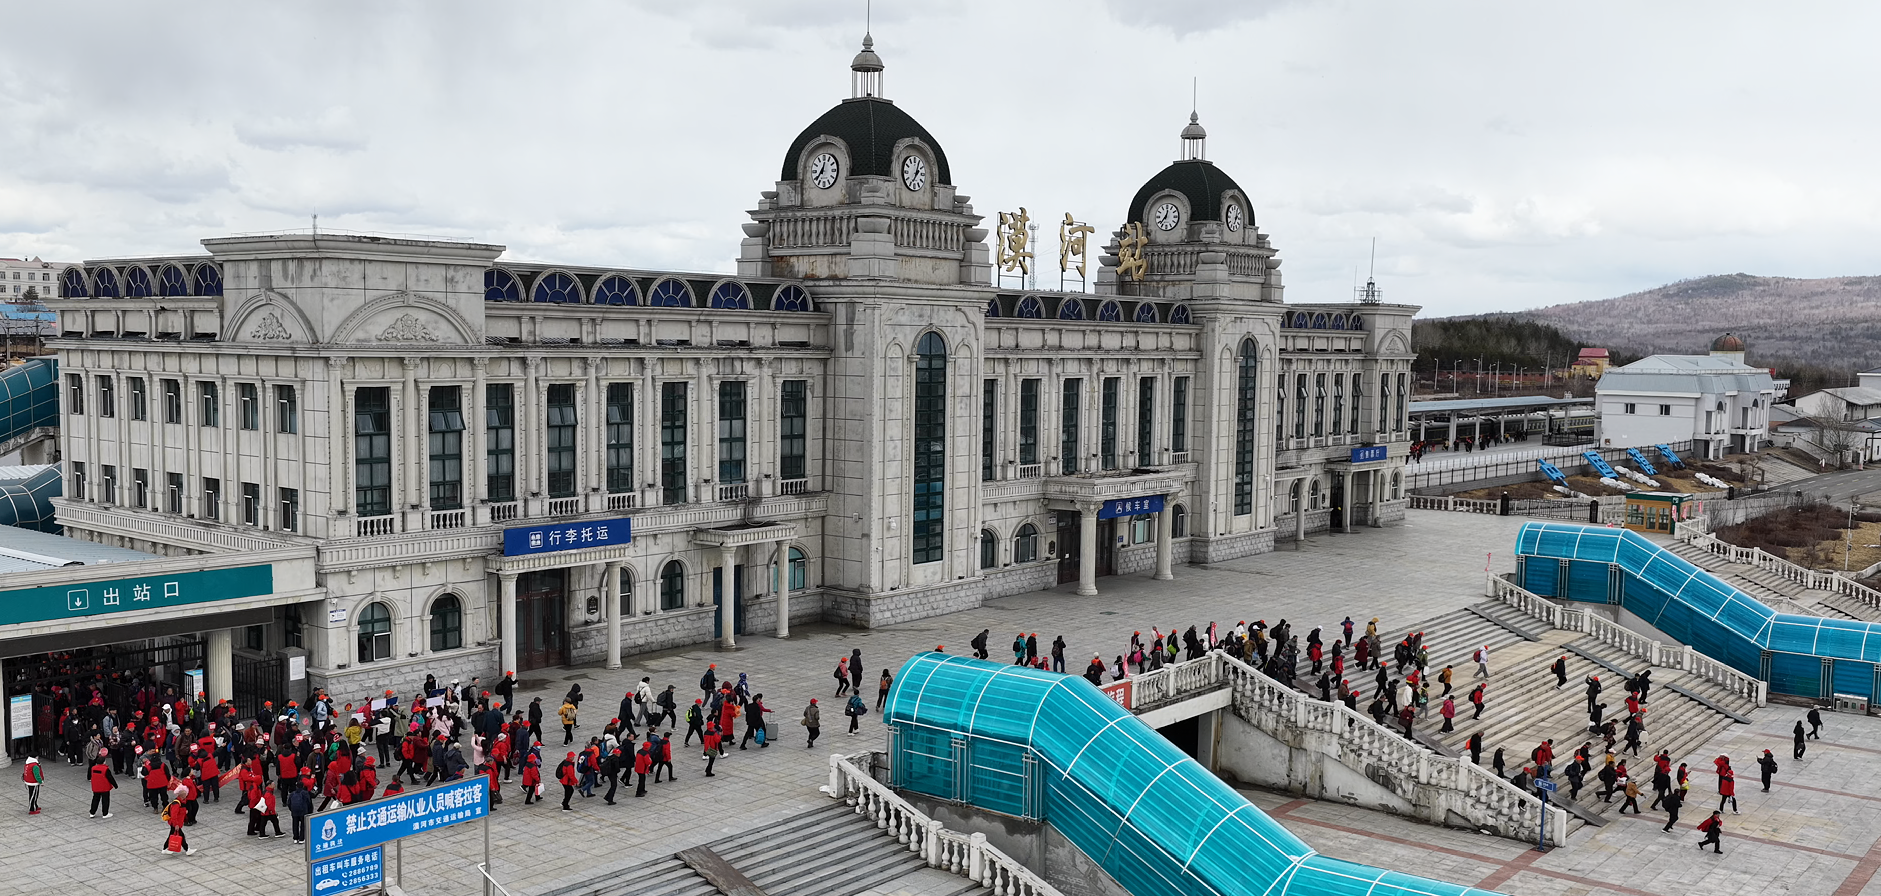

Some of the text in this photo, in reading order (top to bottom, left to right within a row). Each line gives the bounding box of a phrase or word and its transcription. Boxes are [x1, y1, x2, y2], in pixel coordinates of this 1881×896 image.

[997, 207, 1148, 281] 漠河站
[1125, 499, 1149, 512] 候车室
[549, 526, 609, 546] 行李托运
[103, 581, 179, 606] 出站口
[346, 783, 482, 835] 禁止交通运输从业人员喊客拉客
[412, 809, 471, 831] 漠河市交通运输局
[315, 851, 378, 876] 出租车叫车服务电话
[348, 864, 378, 877] 2886789
[348, 872, 378, 886] 2856333
